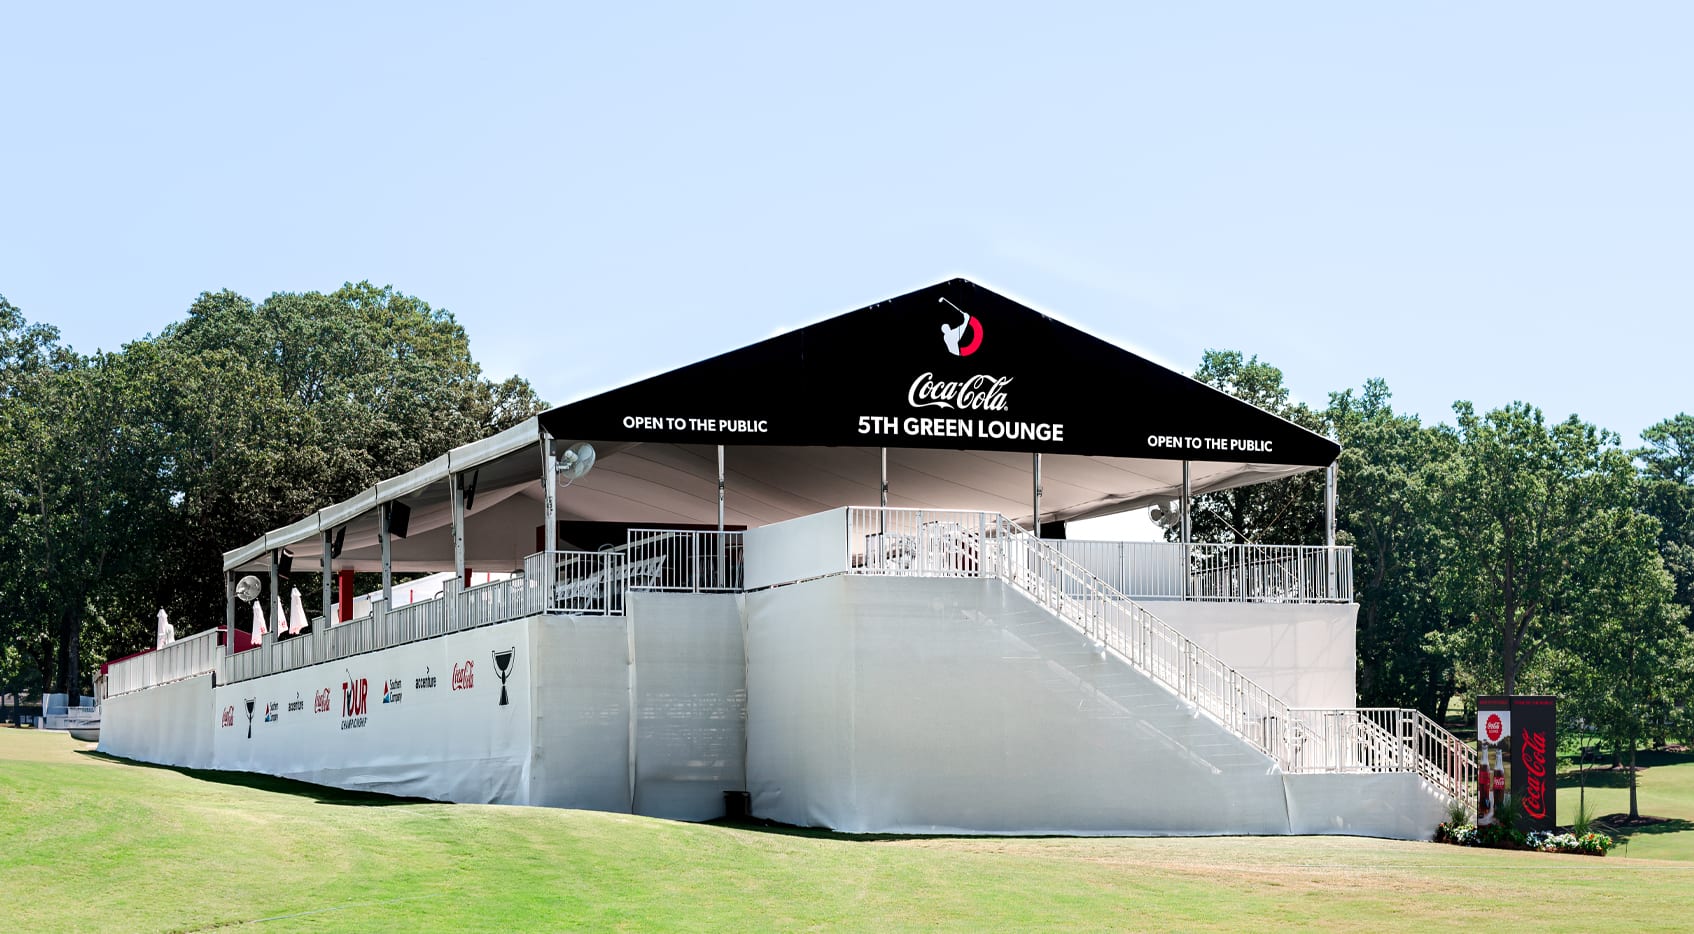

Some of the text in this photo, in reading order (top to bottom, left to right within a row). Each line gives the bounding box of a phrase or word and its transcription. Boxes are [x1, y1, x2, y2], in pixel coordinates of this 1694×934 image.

[908, 372, 1013, 411] Coca-Cola
[623, 416, 767, 433] OPEN TO THE PUBLIC
[858, 416, 1063, 441] 5TH GREEN LOUNGE
[1147, 435, 1272, 452] OPEN TO THE PUBLIC
[415, 676, 437, 689] accenture
[452, 660, 474, 691] Coca-Cola
[342, 678, 368, 717] TOUR
[1522, 728, 1546, 819] Coca-Cola
